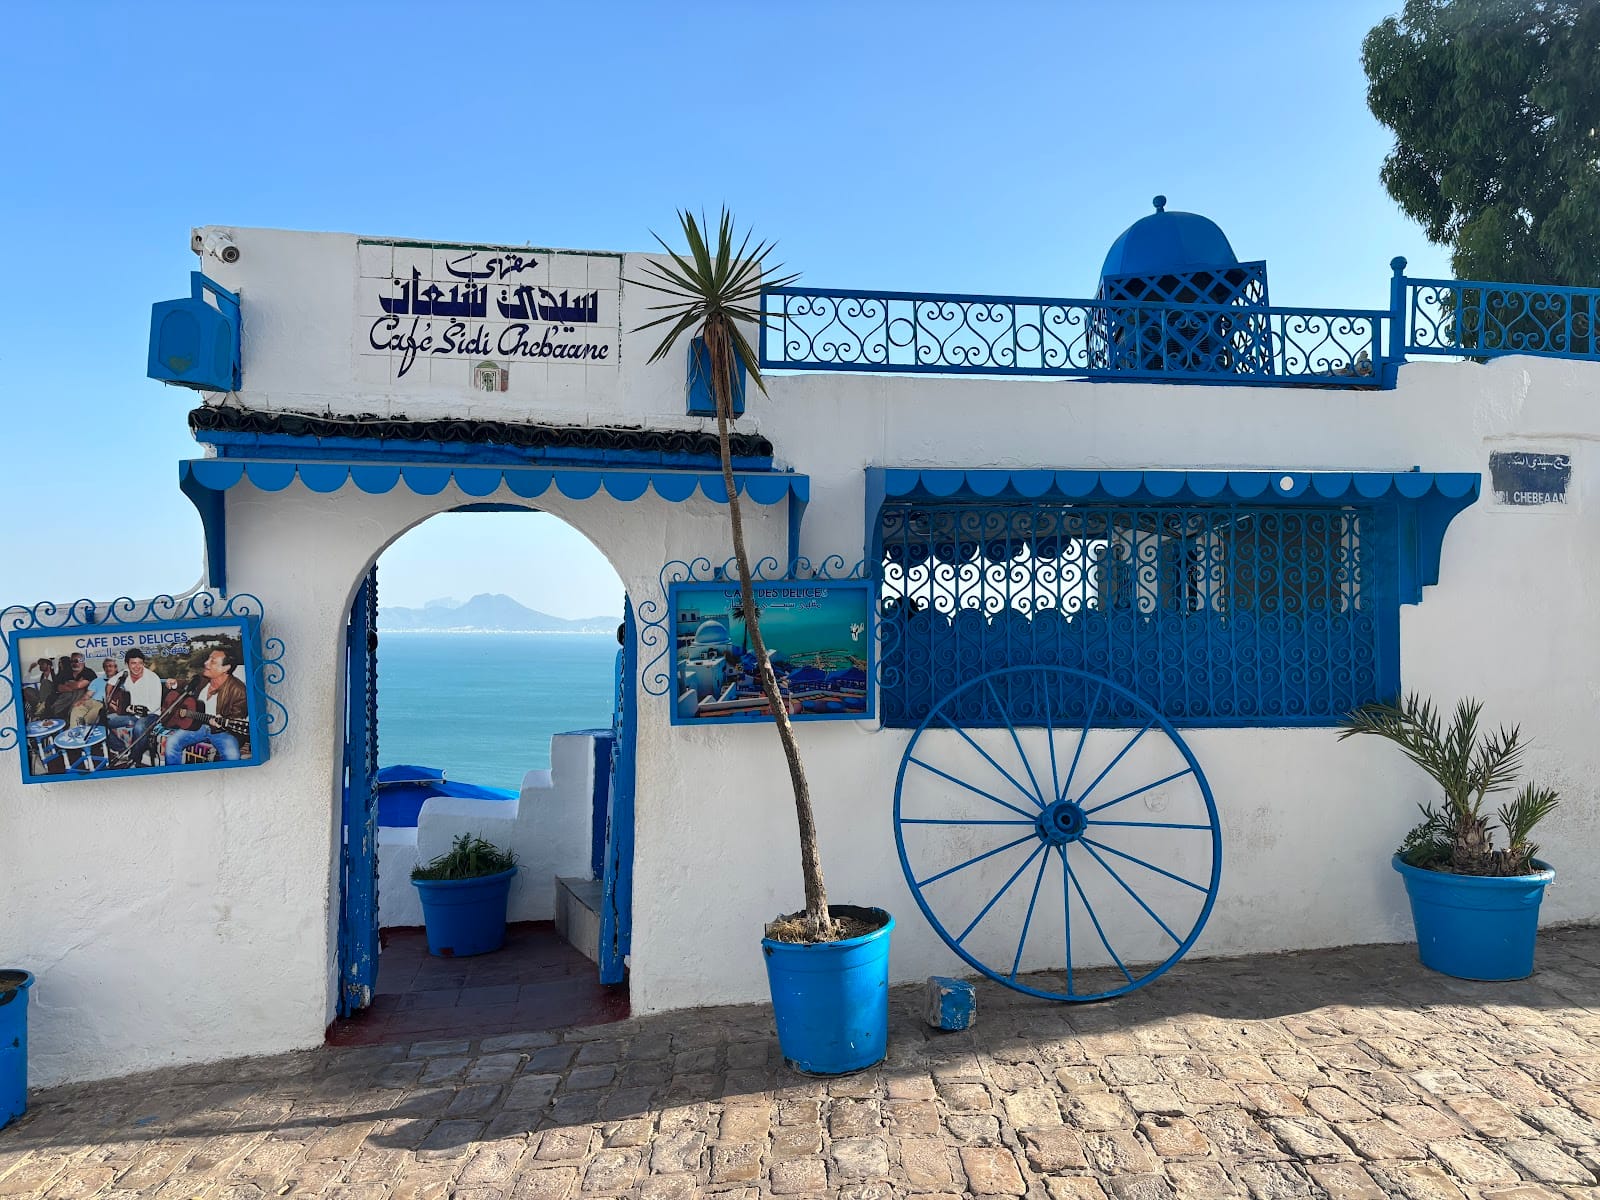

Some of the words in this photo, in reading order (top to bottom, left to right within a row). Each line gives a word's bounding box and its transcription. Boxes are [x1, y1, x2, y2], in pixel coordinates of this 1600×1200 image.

[431, 322, 494, 355] Sidi
[758, 587, 779, 598] DES
[782, 586, 829, 599] DELICES
[75, 637, 108, 649] CAFE
[112, 635, 135, 647] DES
[139, 632, 189, 645] DELICES
